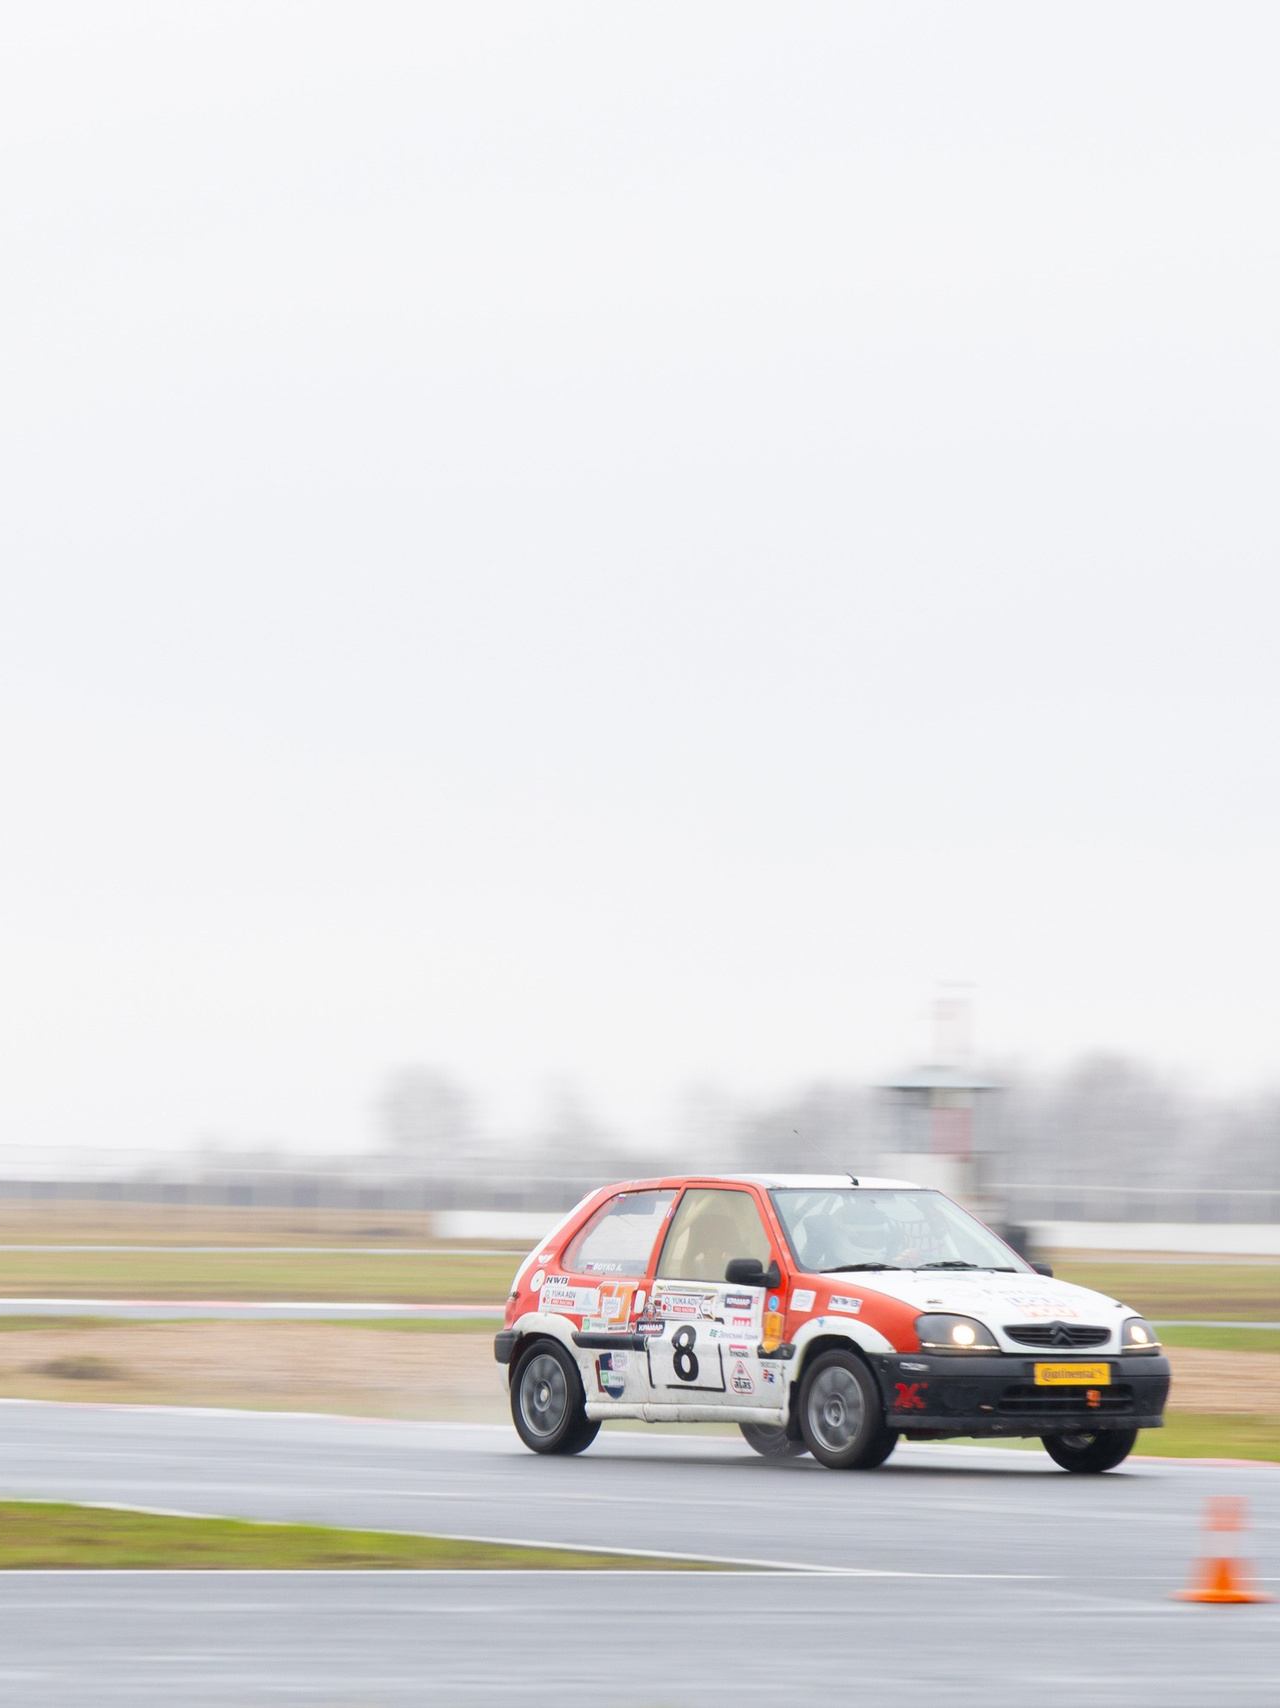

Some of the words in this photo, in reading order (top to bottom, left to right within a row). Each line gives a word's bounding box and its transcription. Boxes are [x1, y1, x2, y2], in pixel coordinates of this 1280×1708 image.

[593, 1262, 616, 1271] BOYKO
[546, 1276, 568, 1285] NWB
[671, 1325, 699, 1382] 8
